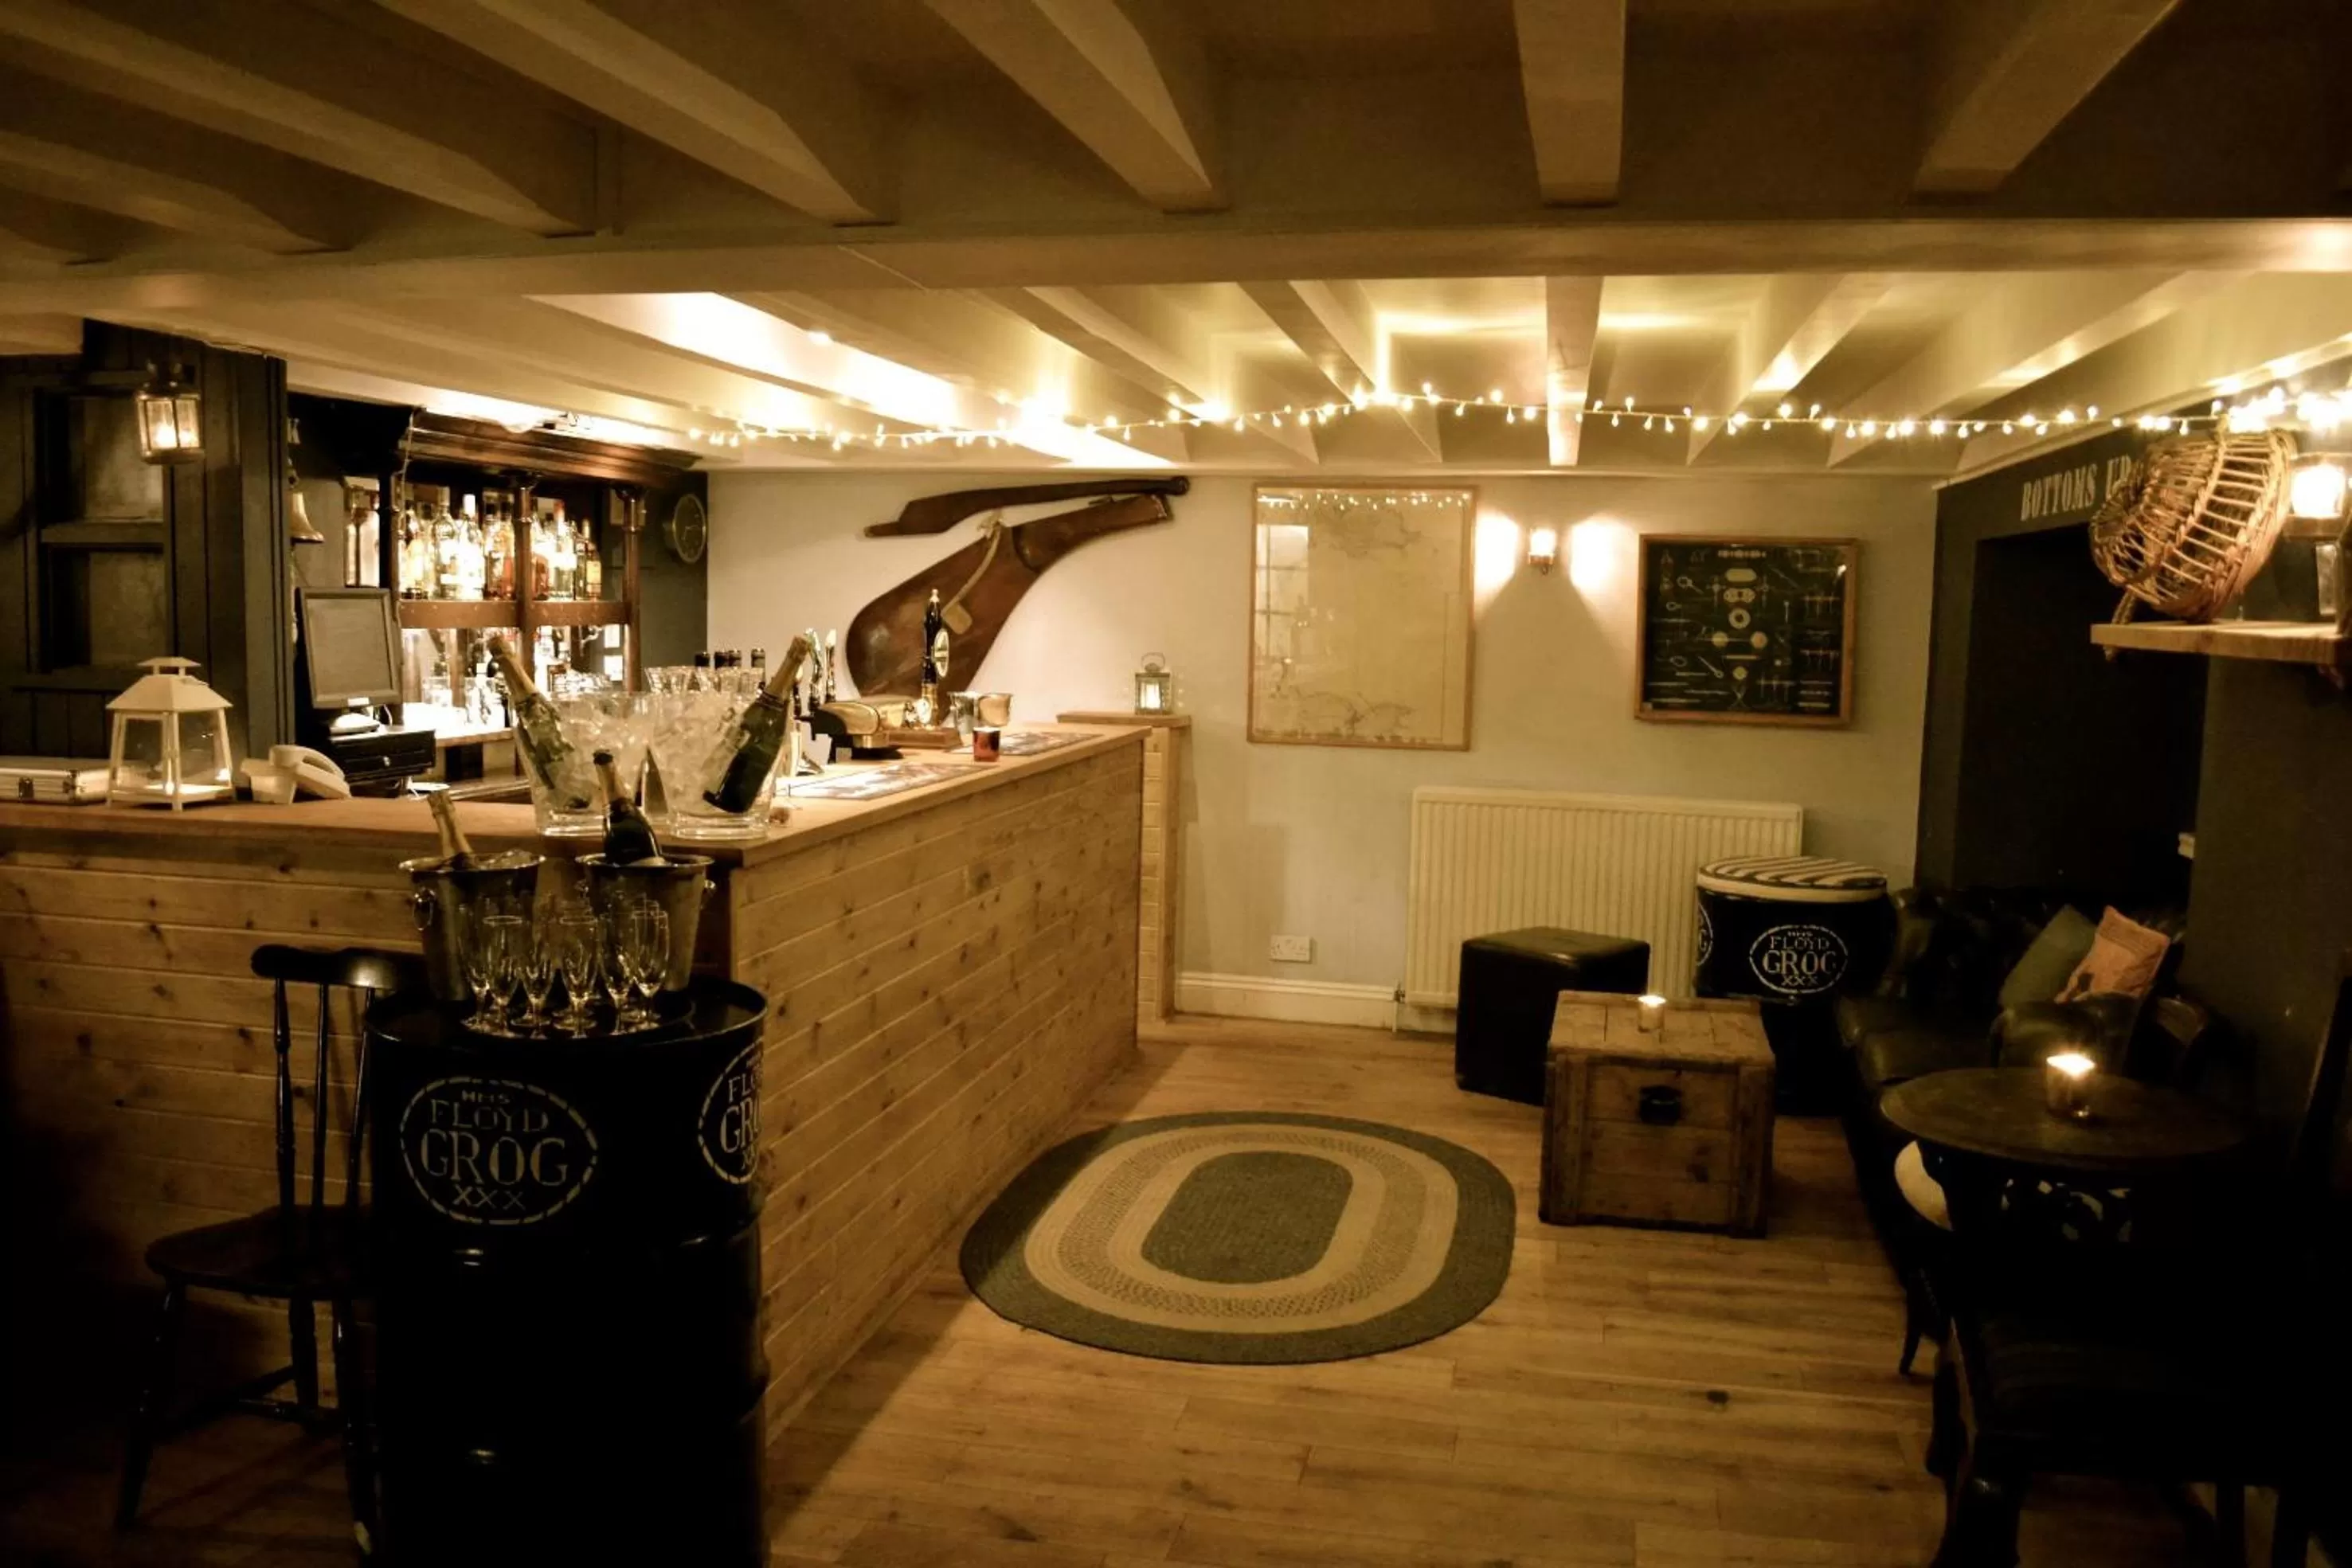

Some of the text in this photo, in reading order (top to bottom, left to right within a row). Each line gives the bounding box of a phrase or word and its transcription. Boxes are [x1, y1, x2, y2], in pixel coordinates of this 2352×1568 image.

[2020, 463, 2098, 522] BOTTOMS
[1769, 936, 1830, 950] FLOYD
[1762, 949, 1837, 975] GROG
[1781, 975, 1820, 987] XXX
[430, 1099, 550, 1132] FLOYD
[421, 1128, 569, 1187] GROG
[452, 1183, 526, 1211] XXX
